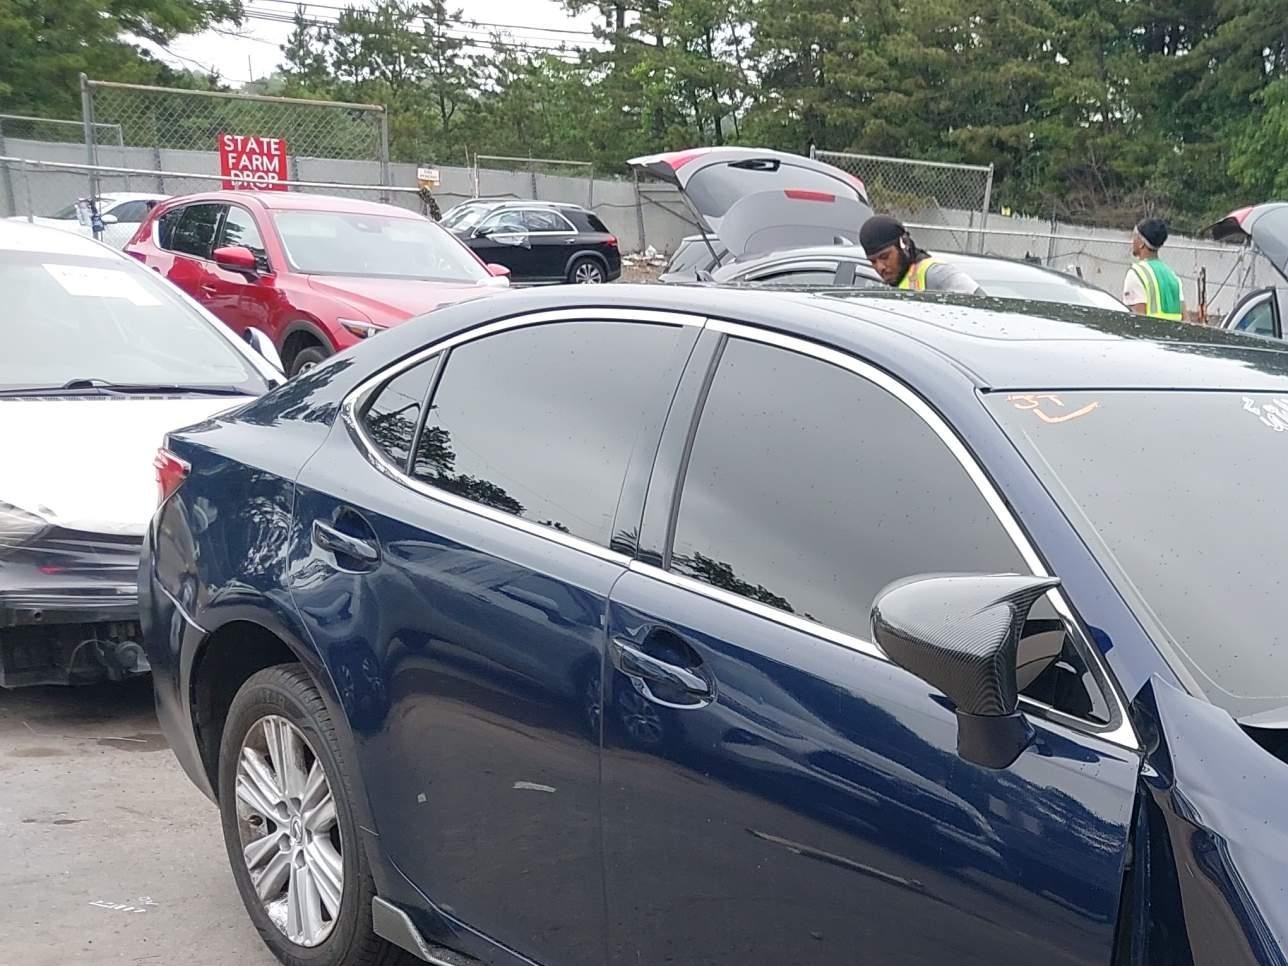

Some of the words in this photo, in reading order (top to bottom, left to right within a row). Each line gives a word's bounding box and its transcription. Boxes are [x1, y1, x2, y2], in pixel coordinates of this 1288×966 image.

[223, 134, 281, 155] STATE
[228, 152, 279, 173] FARM
[230, 169, 279, 191] DROP
